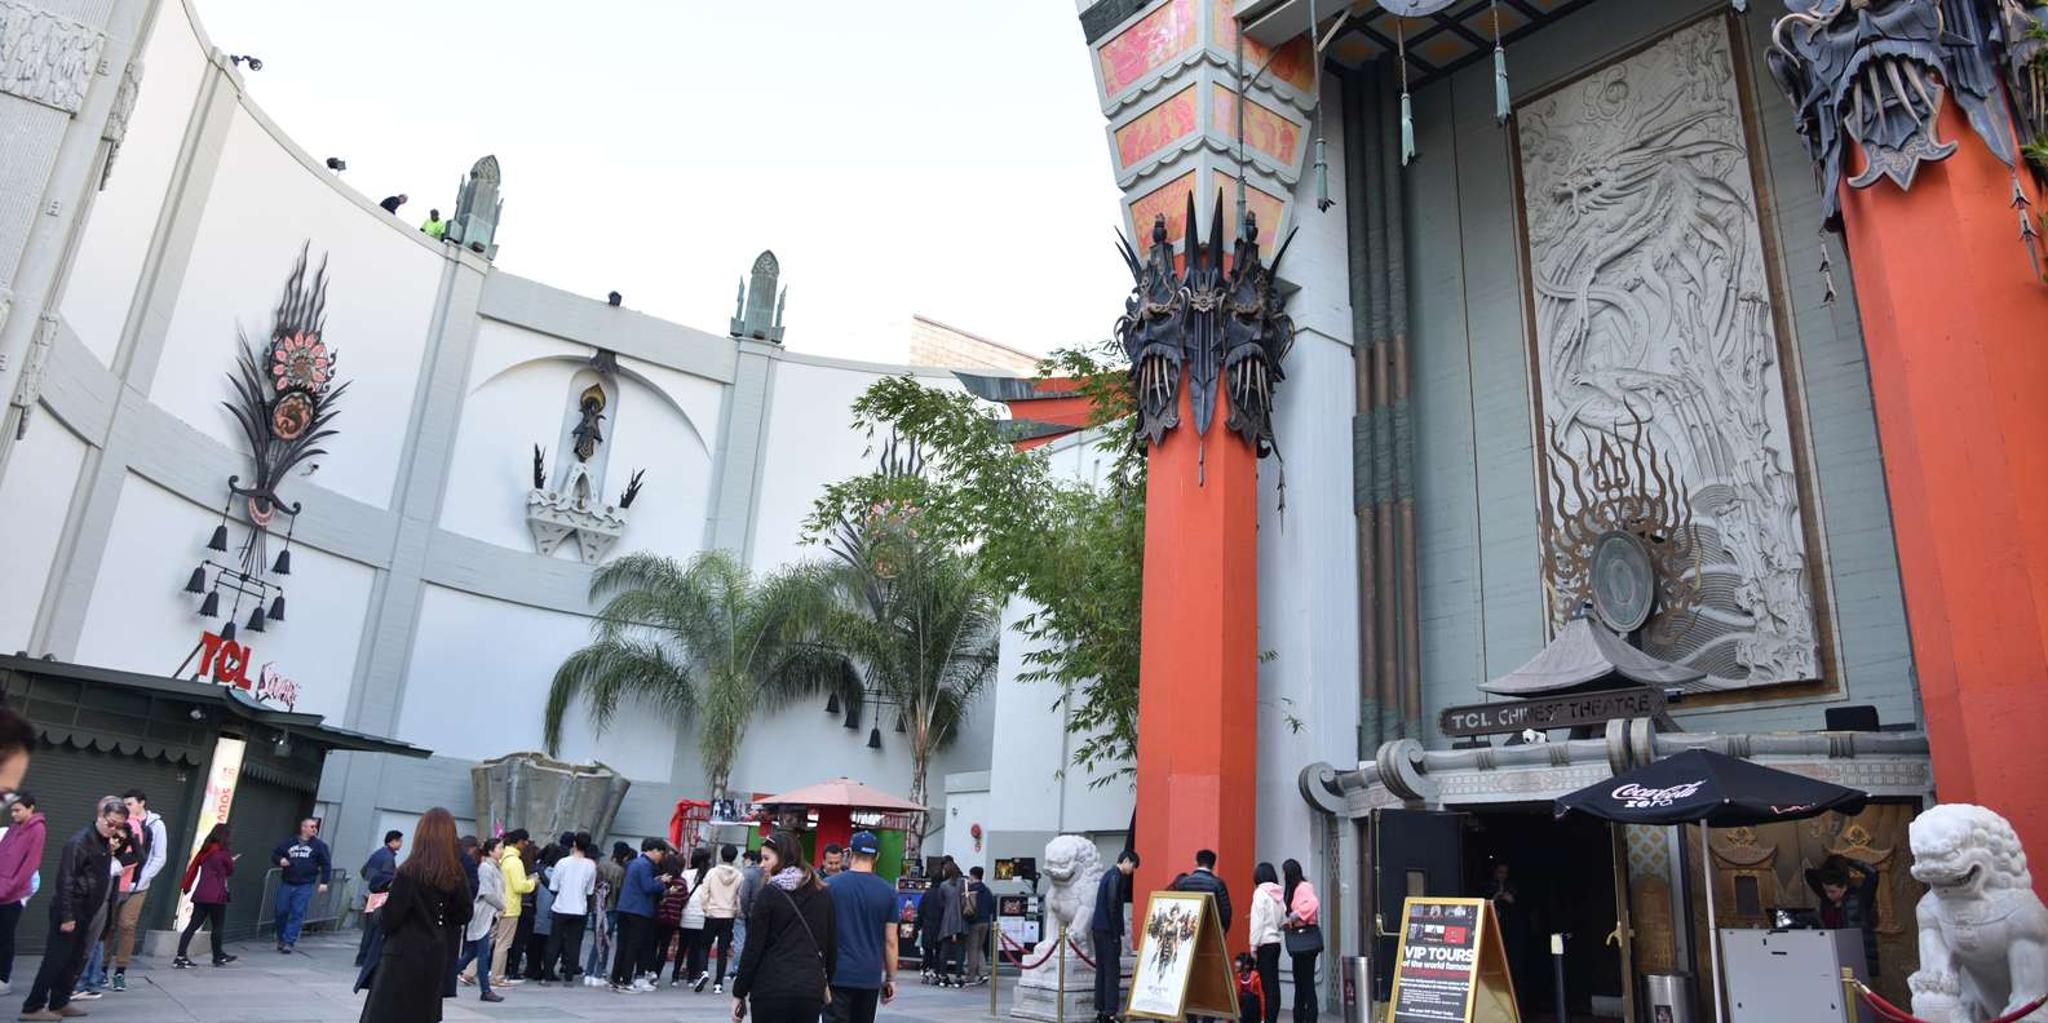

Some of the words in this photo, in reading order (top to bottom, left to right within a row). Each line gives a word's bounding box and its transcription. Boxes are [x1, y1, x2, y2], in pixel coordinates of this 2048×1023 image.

[200, 631, 253, 690] TCL
[1451, 713, 1491, 729] TCL
[1569, 694, 1650, 718] THEATRE
[1624, 799, 1673, 808] zero
[1405, 946, 1427, 959] VIP
[1428, 947, 1474, 962] TOURS
[1424, 961, 1446, 970] world
